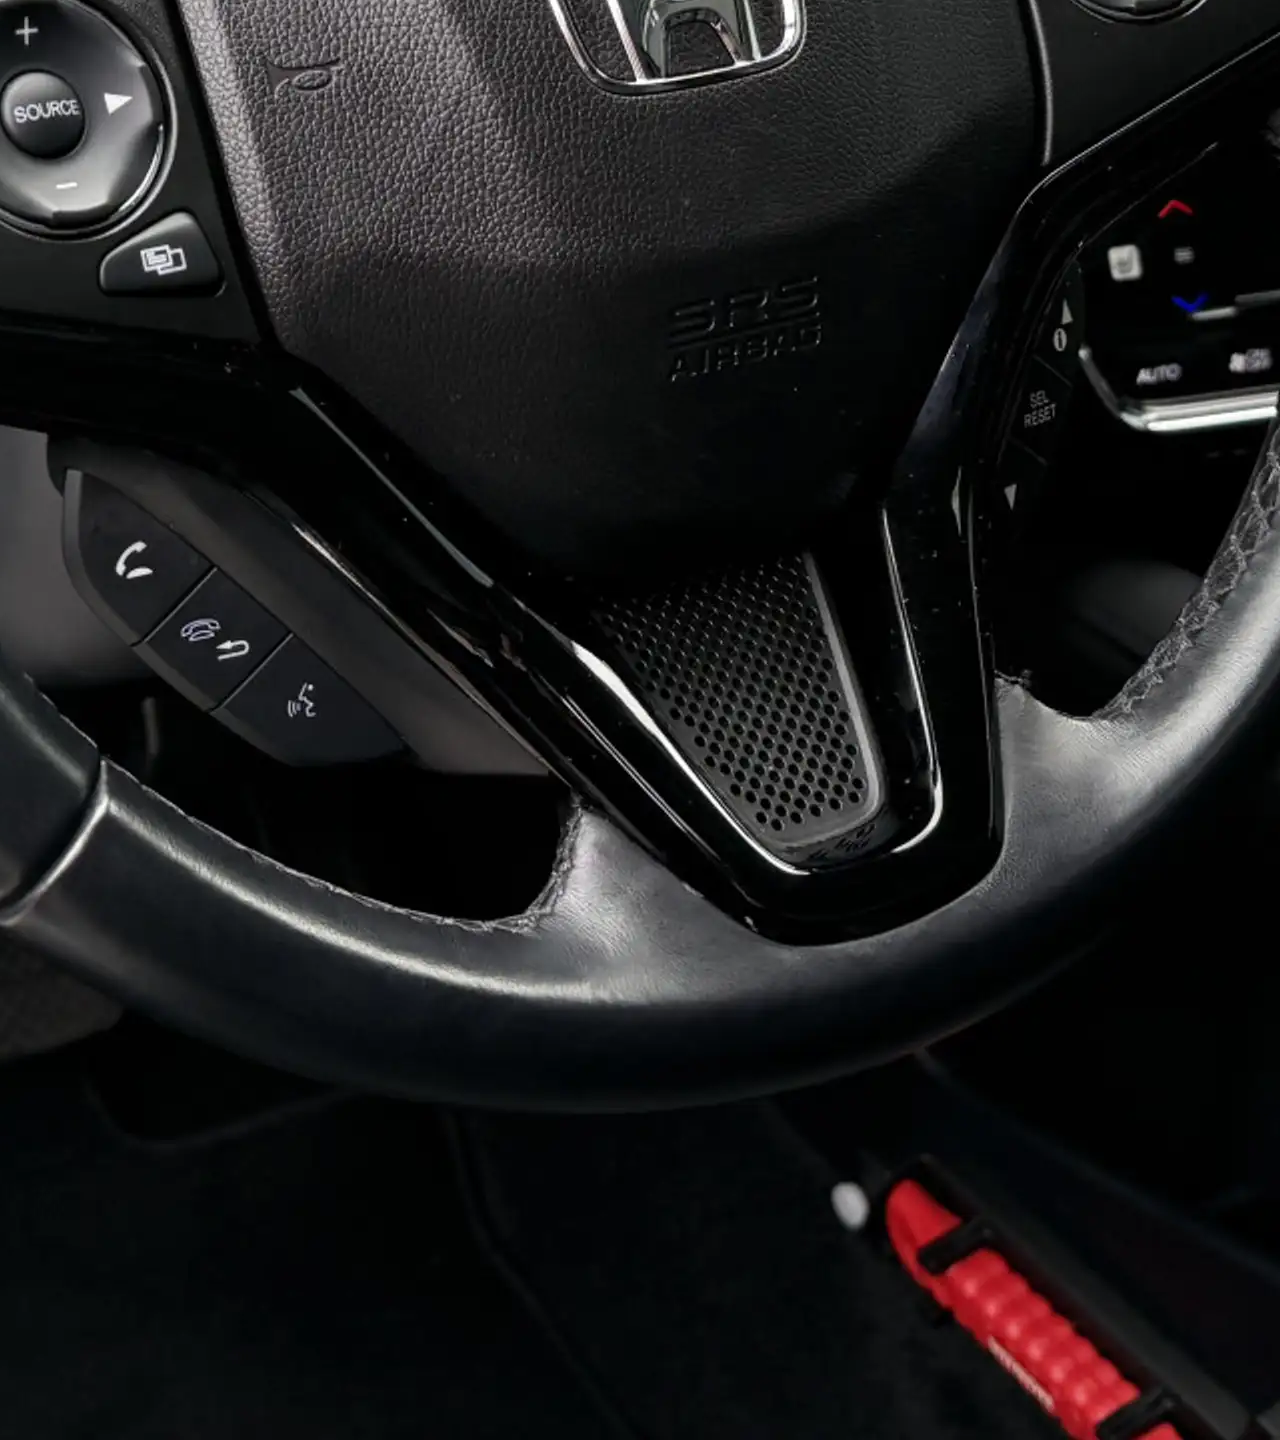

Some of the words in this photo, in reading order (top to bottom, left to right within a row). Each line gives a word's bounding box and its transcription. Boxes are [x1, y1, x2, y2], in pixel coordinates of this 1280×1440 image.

[13, 99, 81, 123] SOURCE
[1136, 363, 1183, 385] AUTO
[1029, 390, 1051, 409] SEL
[1023, 403, 1057, 428] RESET
